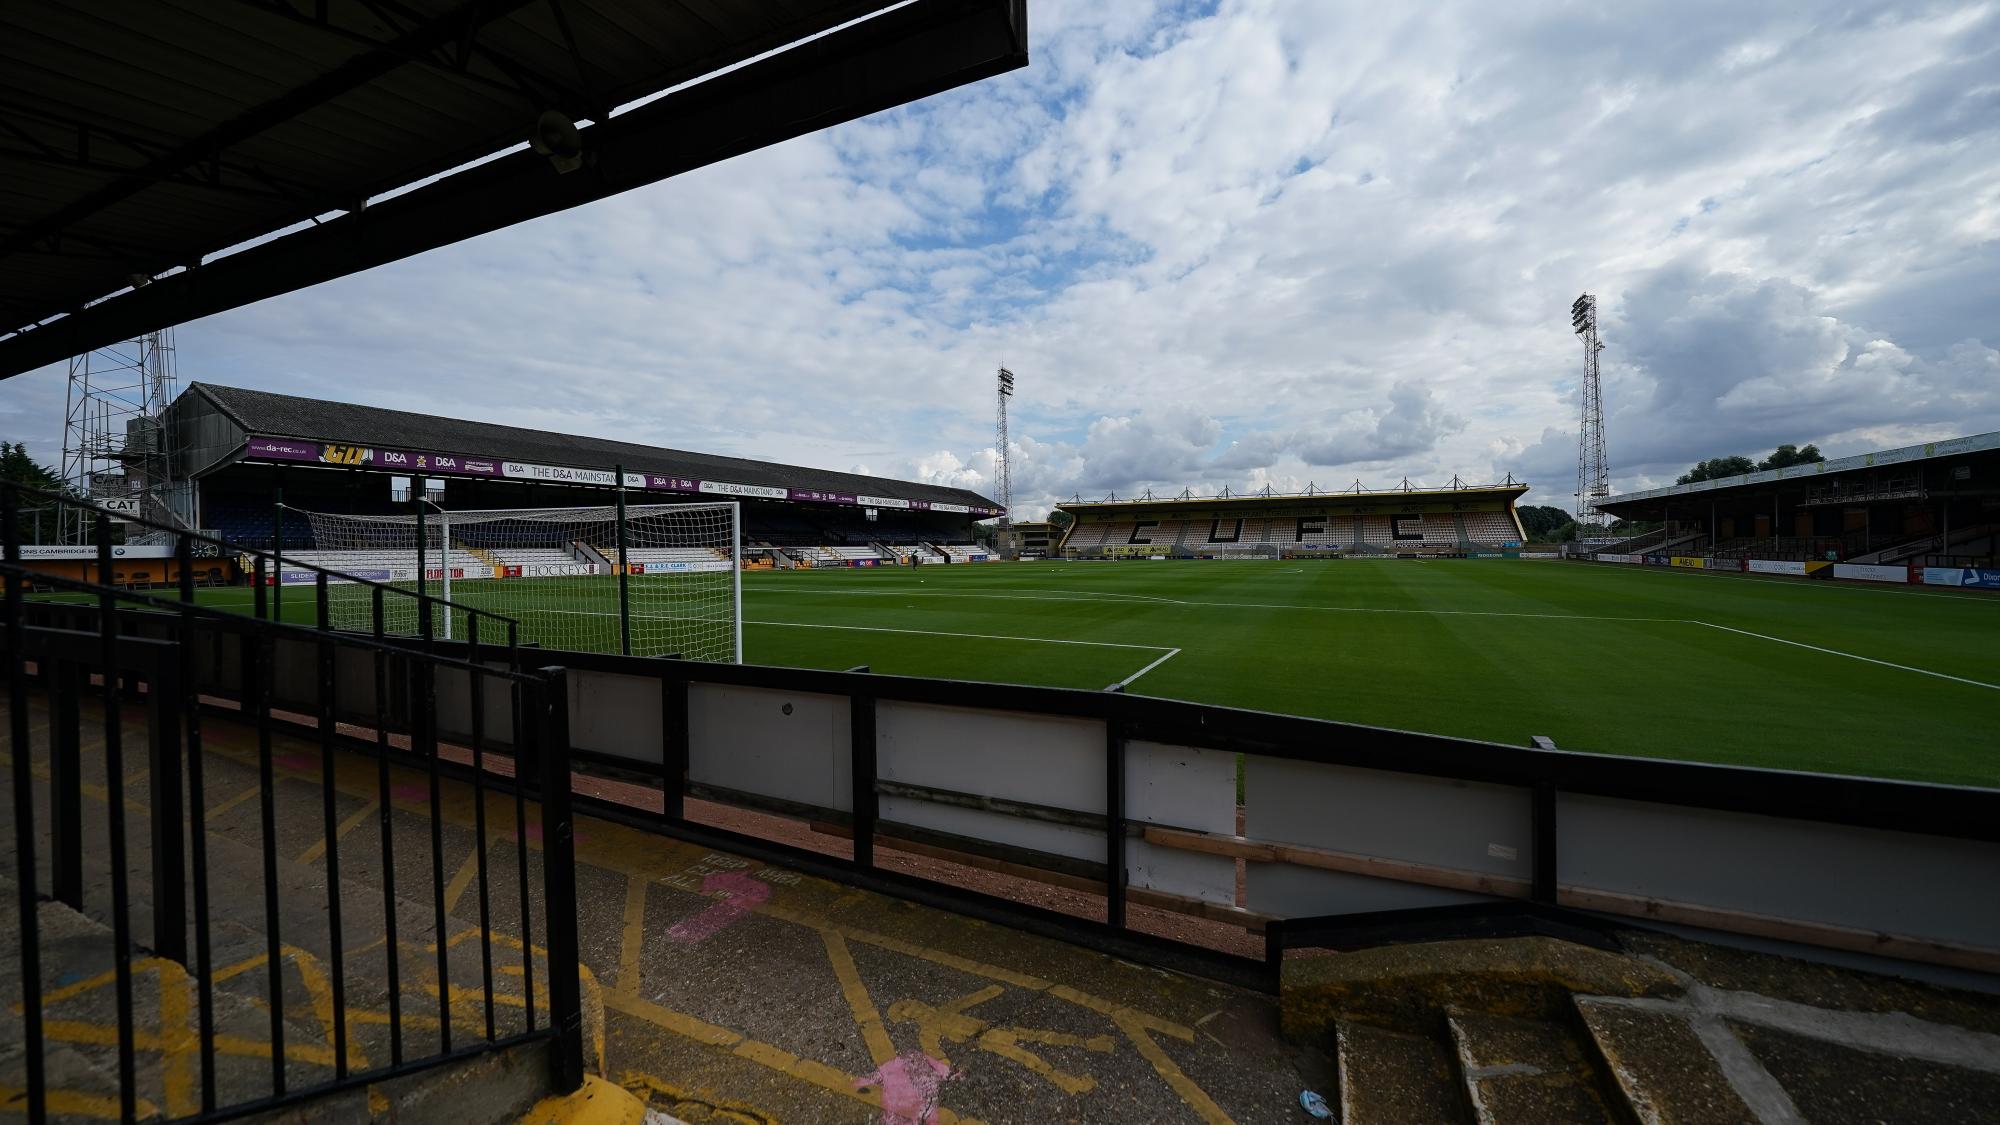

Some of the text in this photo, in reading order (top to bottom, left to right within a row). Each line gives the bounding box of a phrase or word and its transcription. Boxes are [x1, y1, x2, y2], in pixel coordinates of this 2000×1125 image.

[384, 452, 407, 463] D&A
[435, 457, 456, 467] D&A
[509, 465, 524, 473] D&A
[532, 467, 617, 483] THE D&A MAINSTAN
[718, 484, 728, 492] THE
[106, 501, 135, 509] CAT
[1127, 514, 1424, 544] C U F C
[528, 565, 588, 576] HOCKEYS
